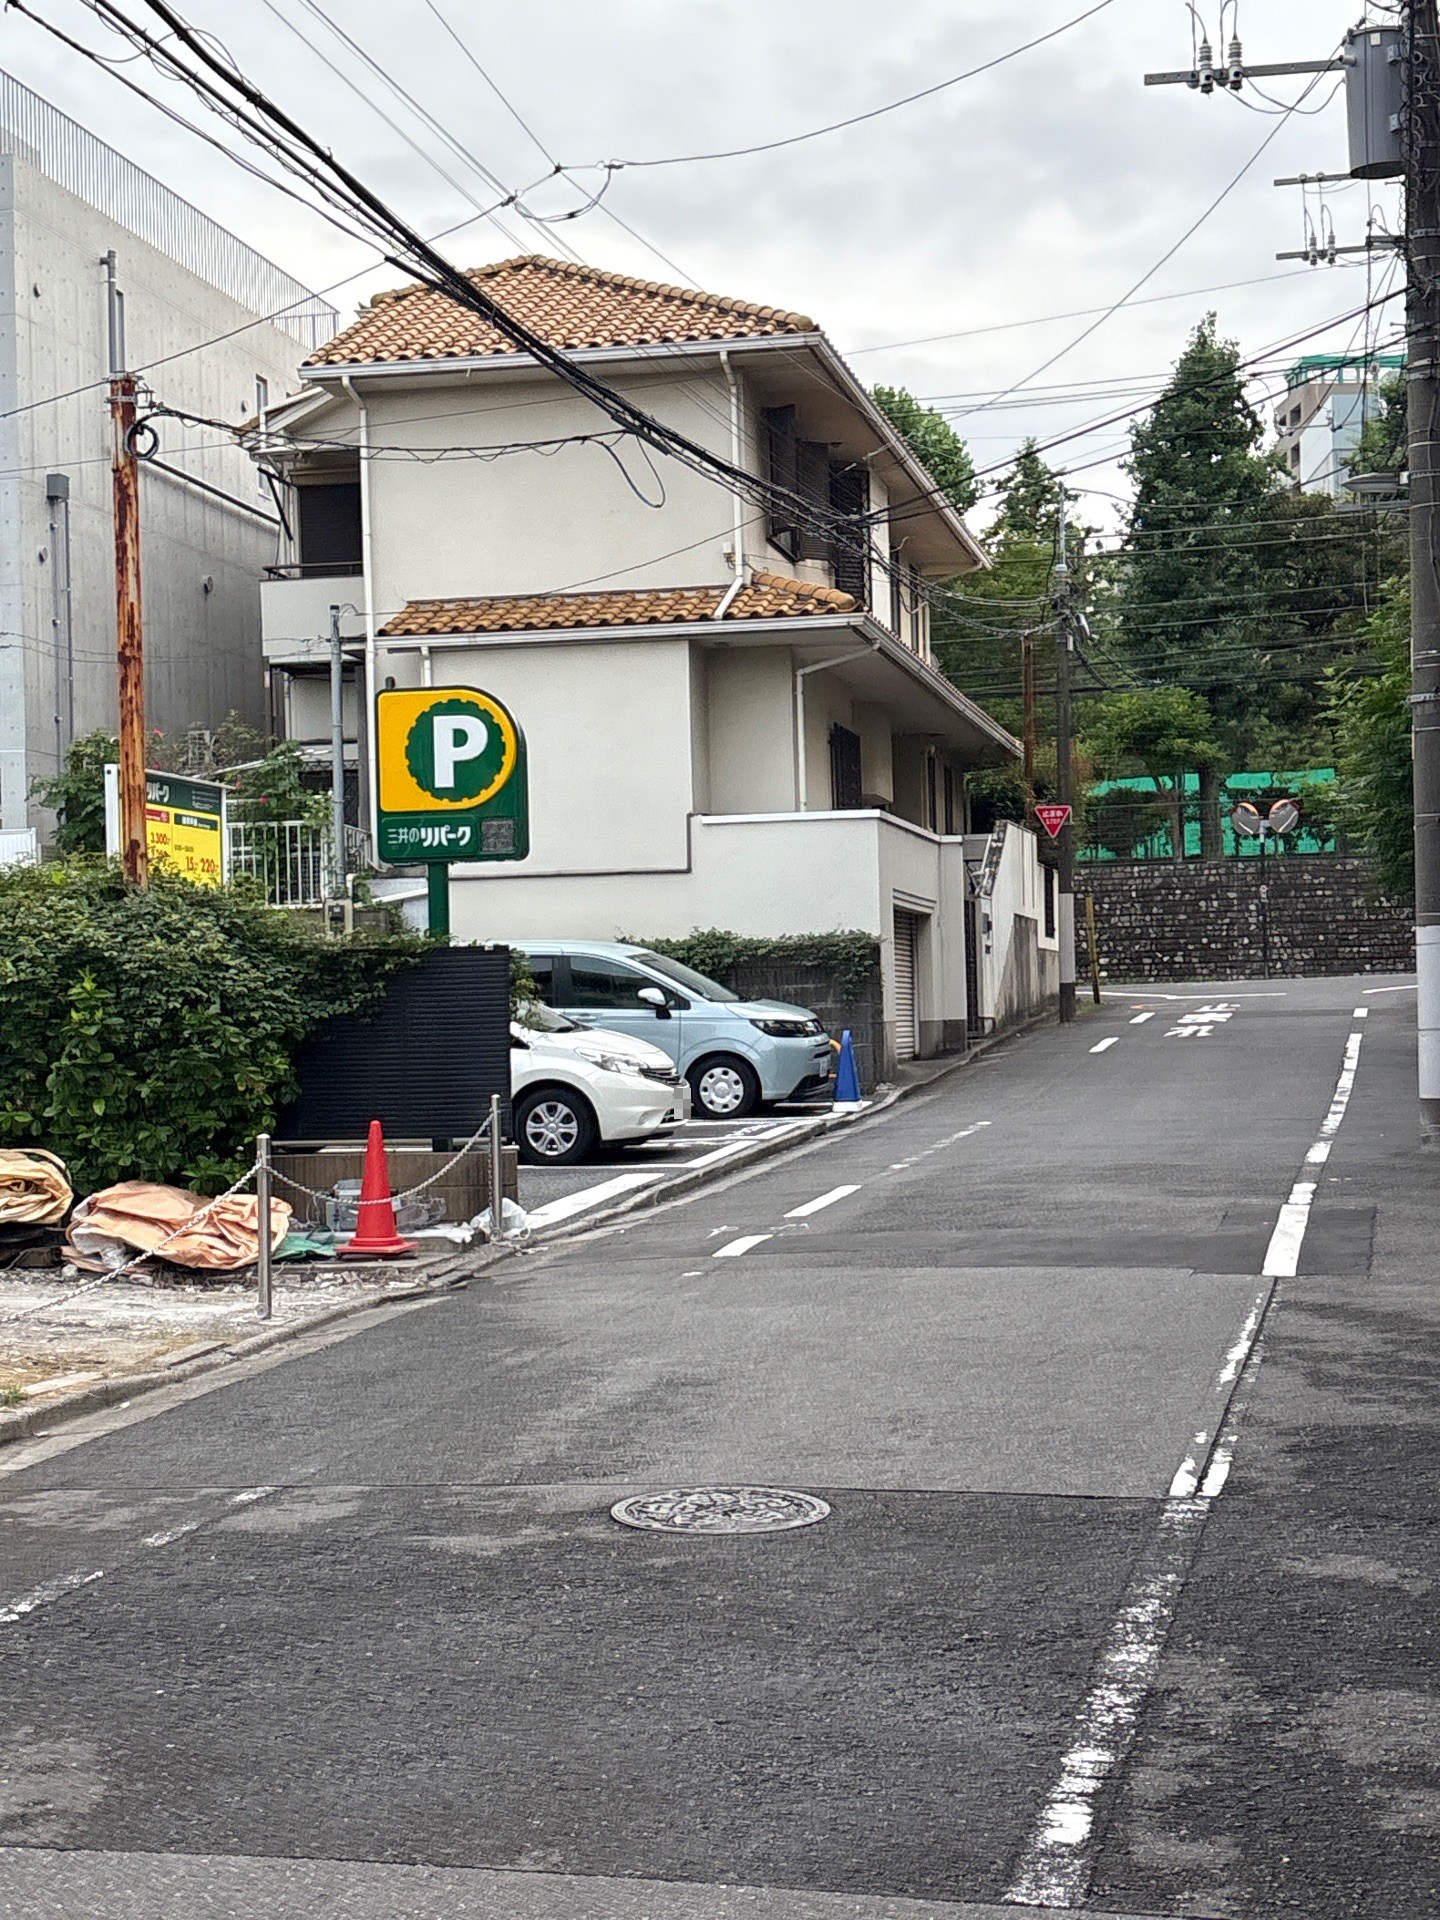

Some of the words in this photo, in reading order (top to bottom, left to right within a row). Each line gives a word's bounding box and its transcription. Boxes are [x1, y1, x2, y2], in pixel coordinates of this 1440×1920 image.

[433, 715, 489, 789] P
[1042, 810, 1064, 818] 止まれ
[387, 825, 472, 847] 三井のリパーク
[1162, 1002, 1241, 1039] 止まれ
